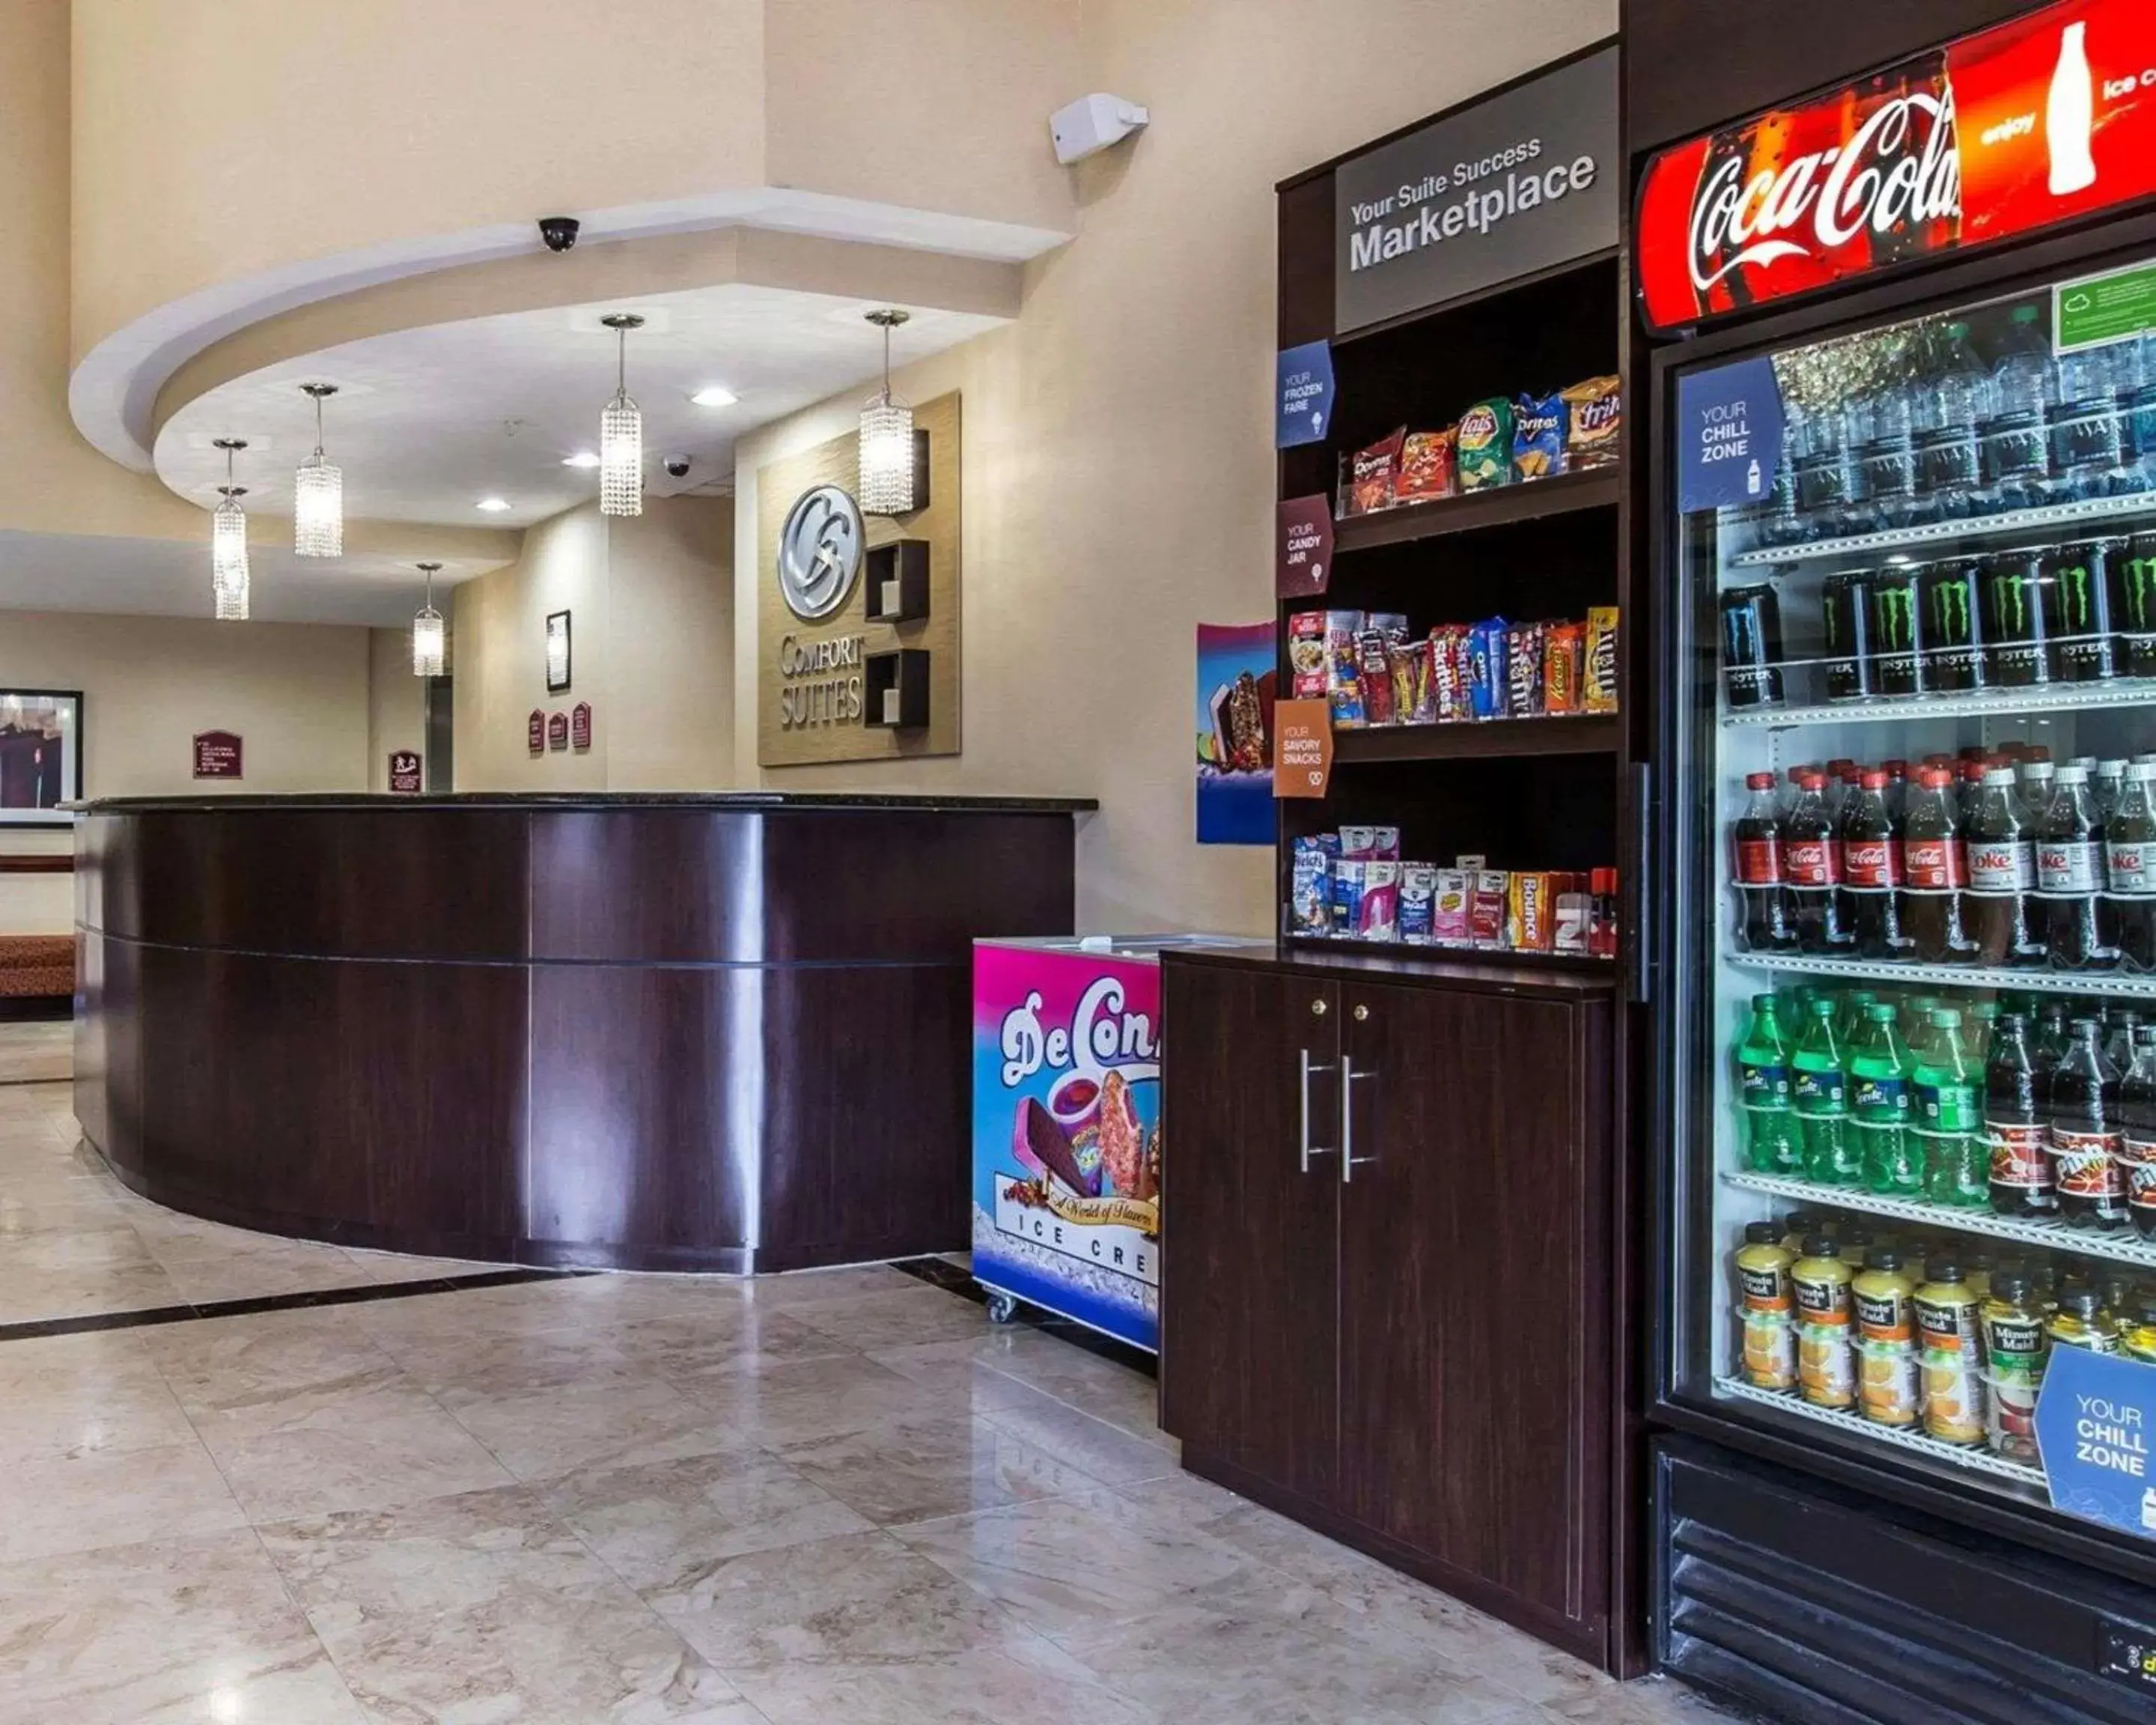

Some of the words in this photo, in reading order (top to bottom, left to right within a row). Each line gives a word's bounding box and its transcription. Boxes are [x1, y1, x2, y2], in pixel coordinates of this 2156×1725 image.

[1980, 112, 2036, 146] enjoy
[1350, 195, 1395, 225] Your
[1398, 174, 1448, 208] Suite
[1453, 139, 1541, 186] Success
[1687, 93, 1962, 290] Coca-Cola
[1350, 155, 1596, 272] Marketplace
[1285, 371, 1311, 387] YOUR
[1285, 381, 1323, 401] FROZEN
[1284, 398, 1309, 414] FARE
[1701, 401, 1747, 425] YOUR
[1702, 420, 1751, 444] CHILL
[1701, 439, 1748, 463] ZONE
[1287, 523, 1314, 538] YOUR
[1288, 535, 1321, 552] CANDY
[1287, 551, 1306, 565] JAR
[1433, 639, 1452, 714] Skittles
[782, 676, 862, 726] SUITES
[1283, 738, 1321, 751] SAVORY
[1283, 752, 1322, 764] SNACKS
[1065, 1199, 1100, 1218] World
[1101, 1203, 1112, 1224] of
[1019, 1214, 1063, 1244] ICE
[1996, 1326, 2038, 1340] Minute
[2003, 1336, 2033, 1351] Maid
[2076, 1393, 2143, 1429] YOUR
[2077, 1417, 2150, 1455] CHILL
[2076, 1440, 2146, 1478] ZONE
